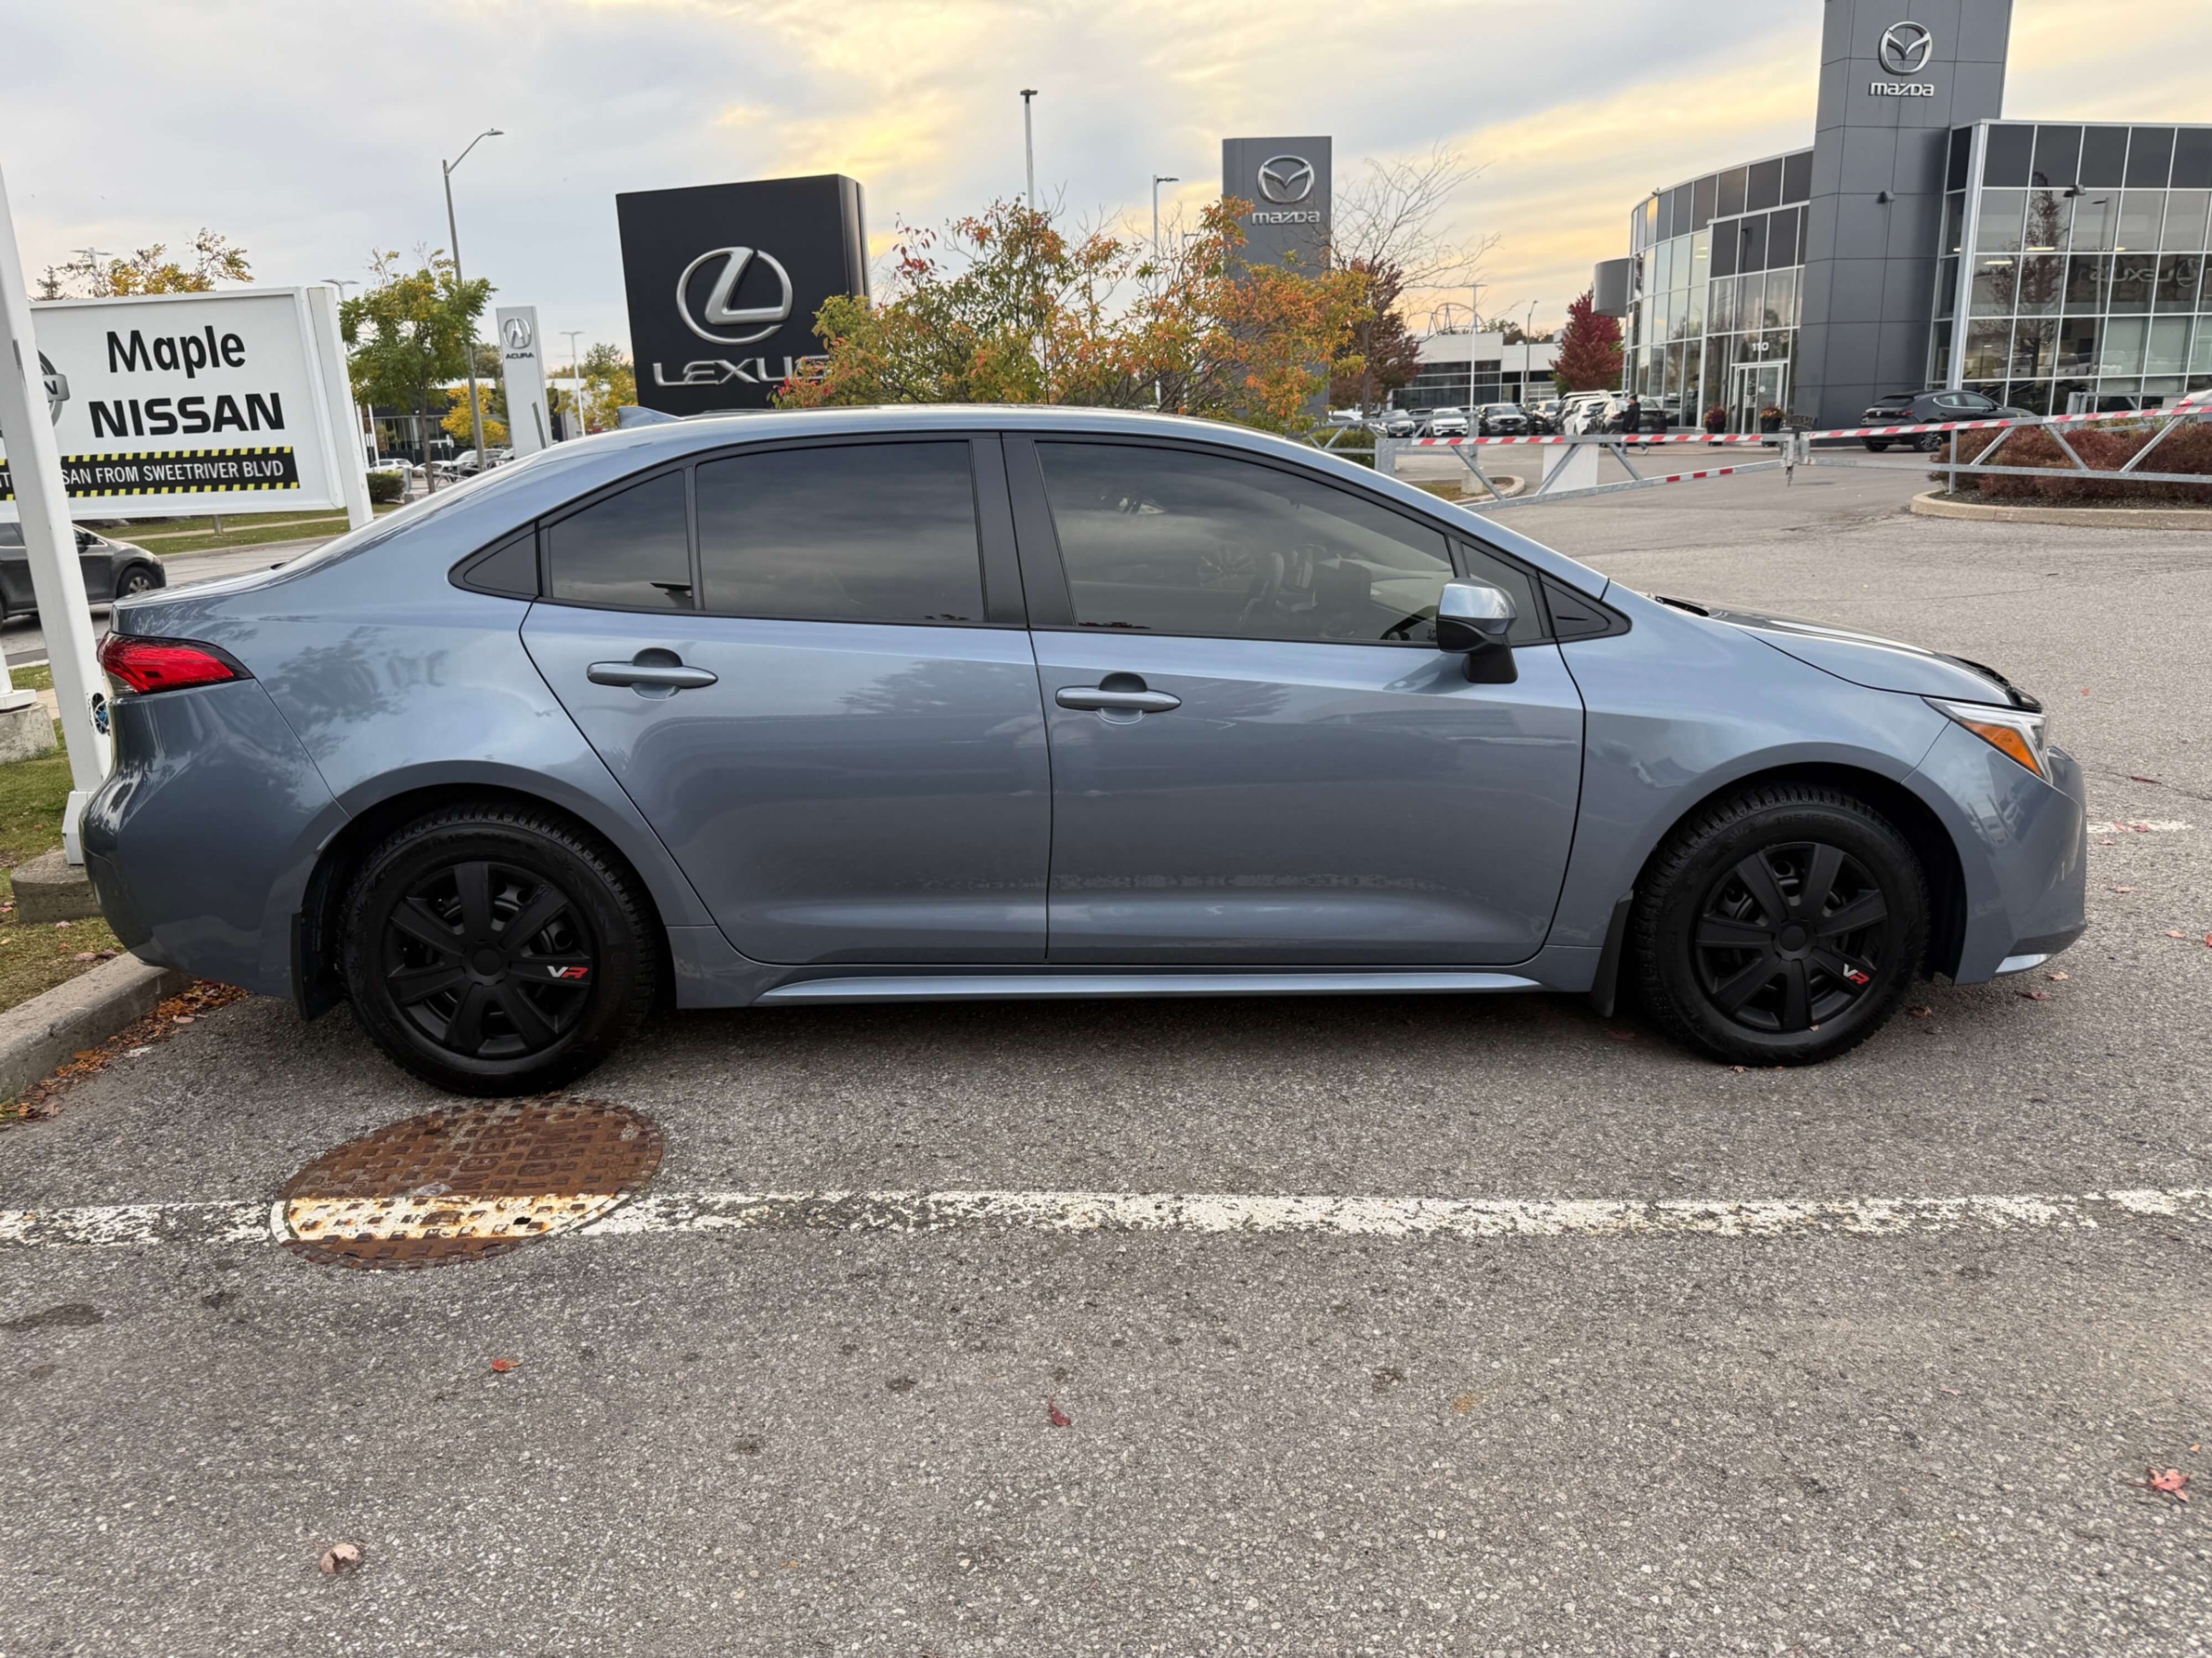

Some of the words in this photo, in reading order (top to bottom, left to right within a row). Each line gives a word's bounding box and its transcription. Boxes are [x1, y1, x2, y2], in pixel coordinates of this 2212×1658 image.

[1869, 82, 1934, 97] mazda
[107, 325, 245, 378] Maple
[89, 393, 285, 438] NISSAN
[96, 466, 140, 484] FROM
[143, 462, 240, 481] SWEETRIVER
[242, 460, 284, 477] BLVD
[547, 966, 588, 978] VR
[1843, 963, 1869, 985] VR
